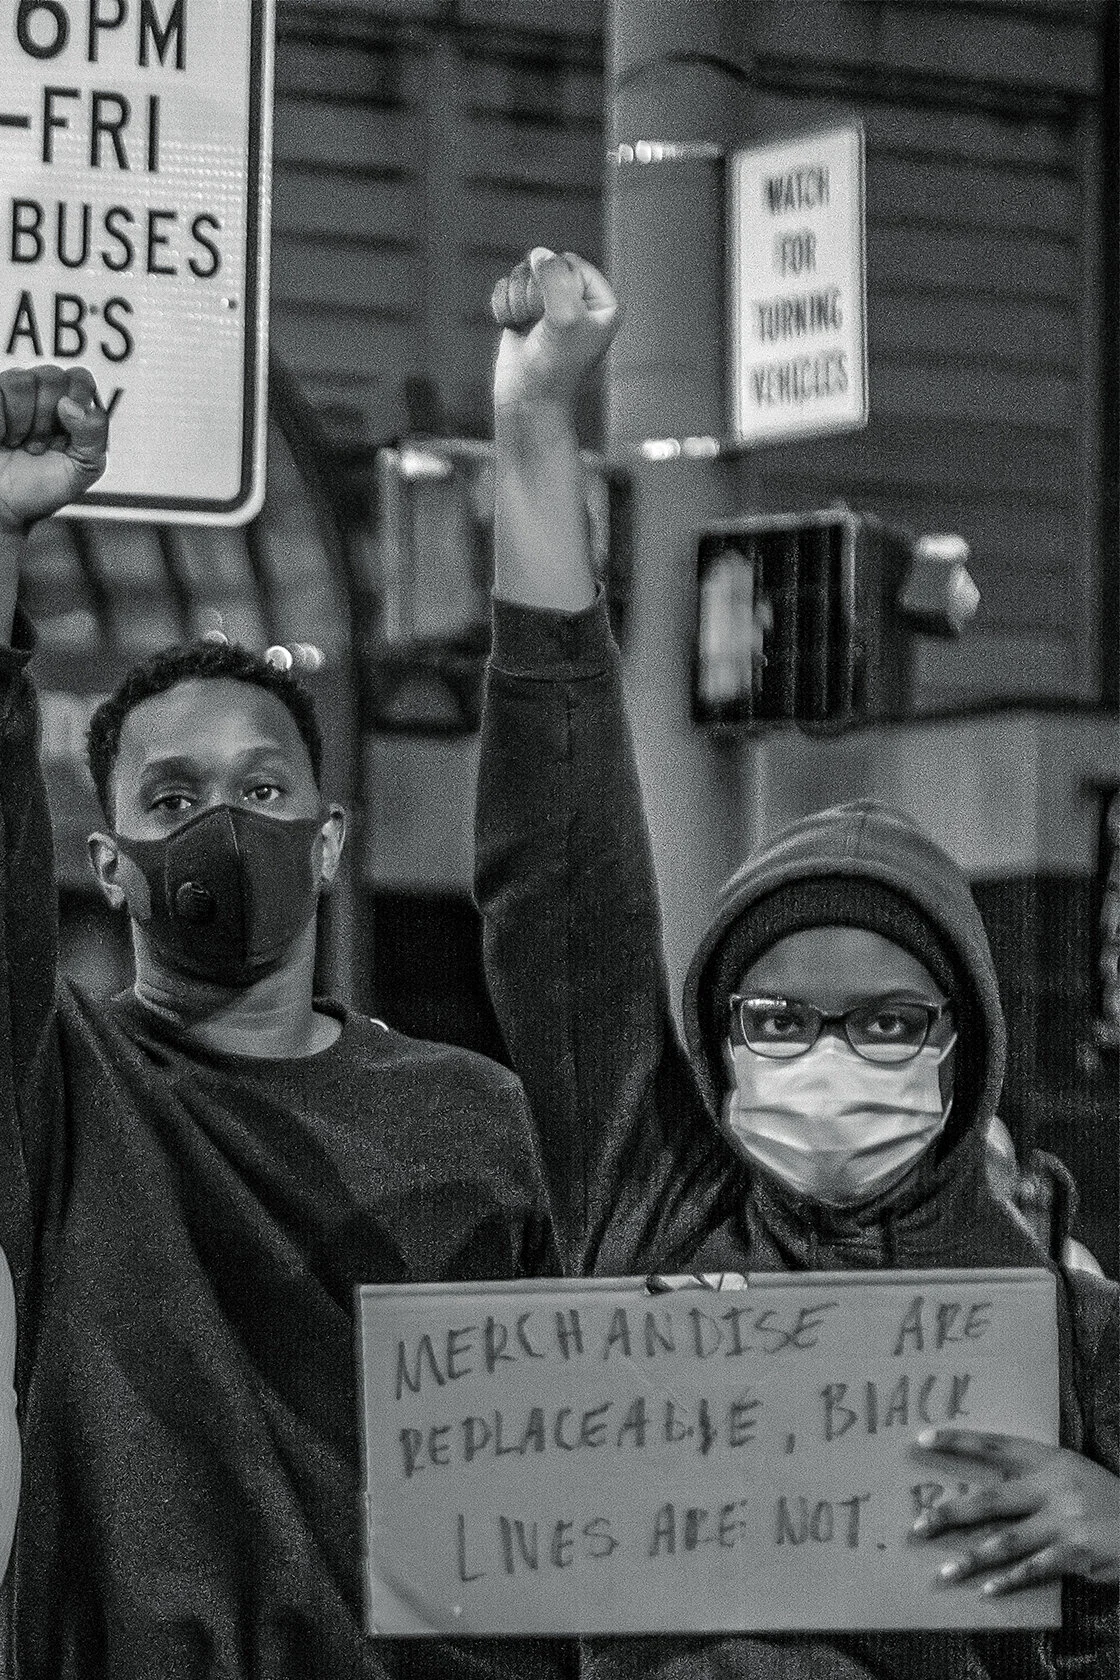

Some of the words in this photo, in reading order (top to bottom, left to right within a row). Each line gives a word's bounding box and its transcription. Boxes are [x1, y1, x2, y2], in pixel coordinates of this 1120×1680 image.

[9, 199, 225, 278] BUSES
[395, 1300, 841, 1401] MERCHANDISE
[892, 1296, 993, 1357] ARE
[455, 1514, 620, 1582] LIVES
[648, 1500, 751, 1558] ARE
